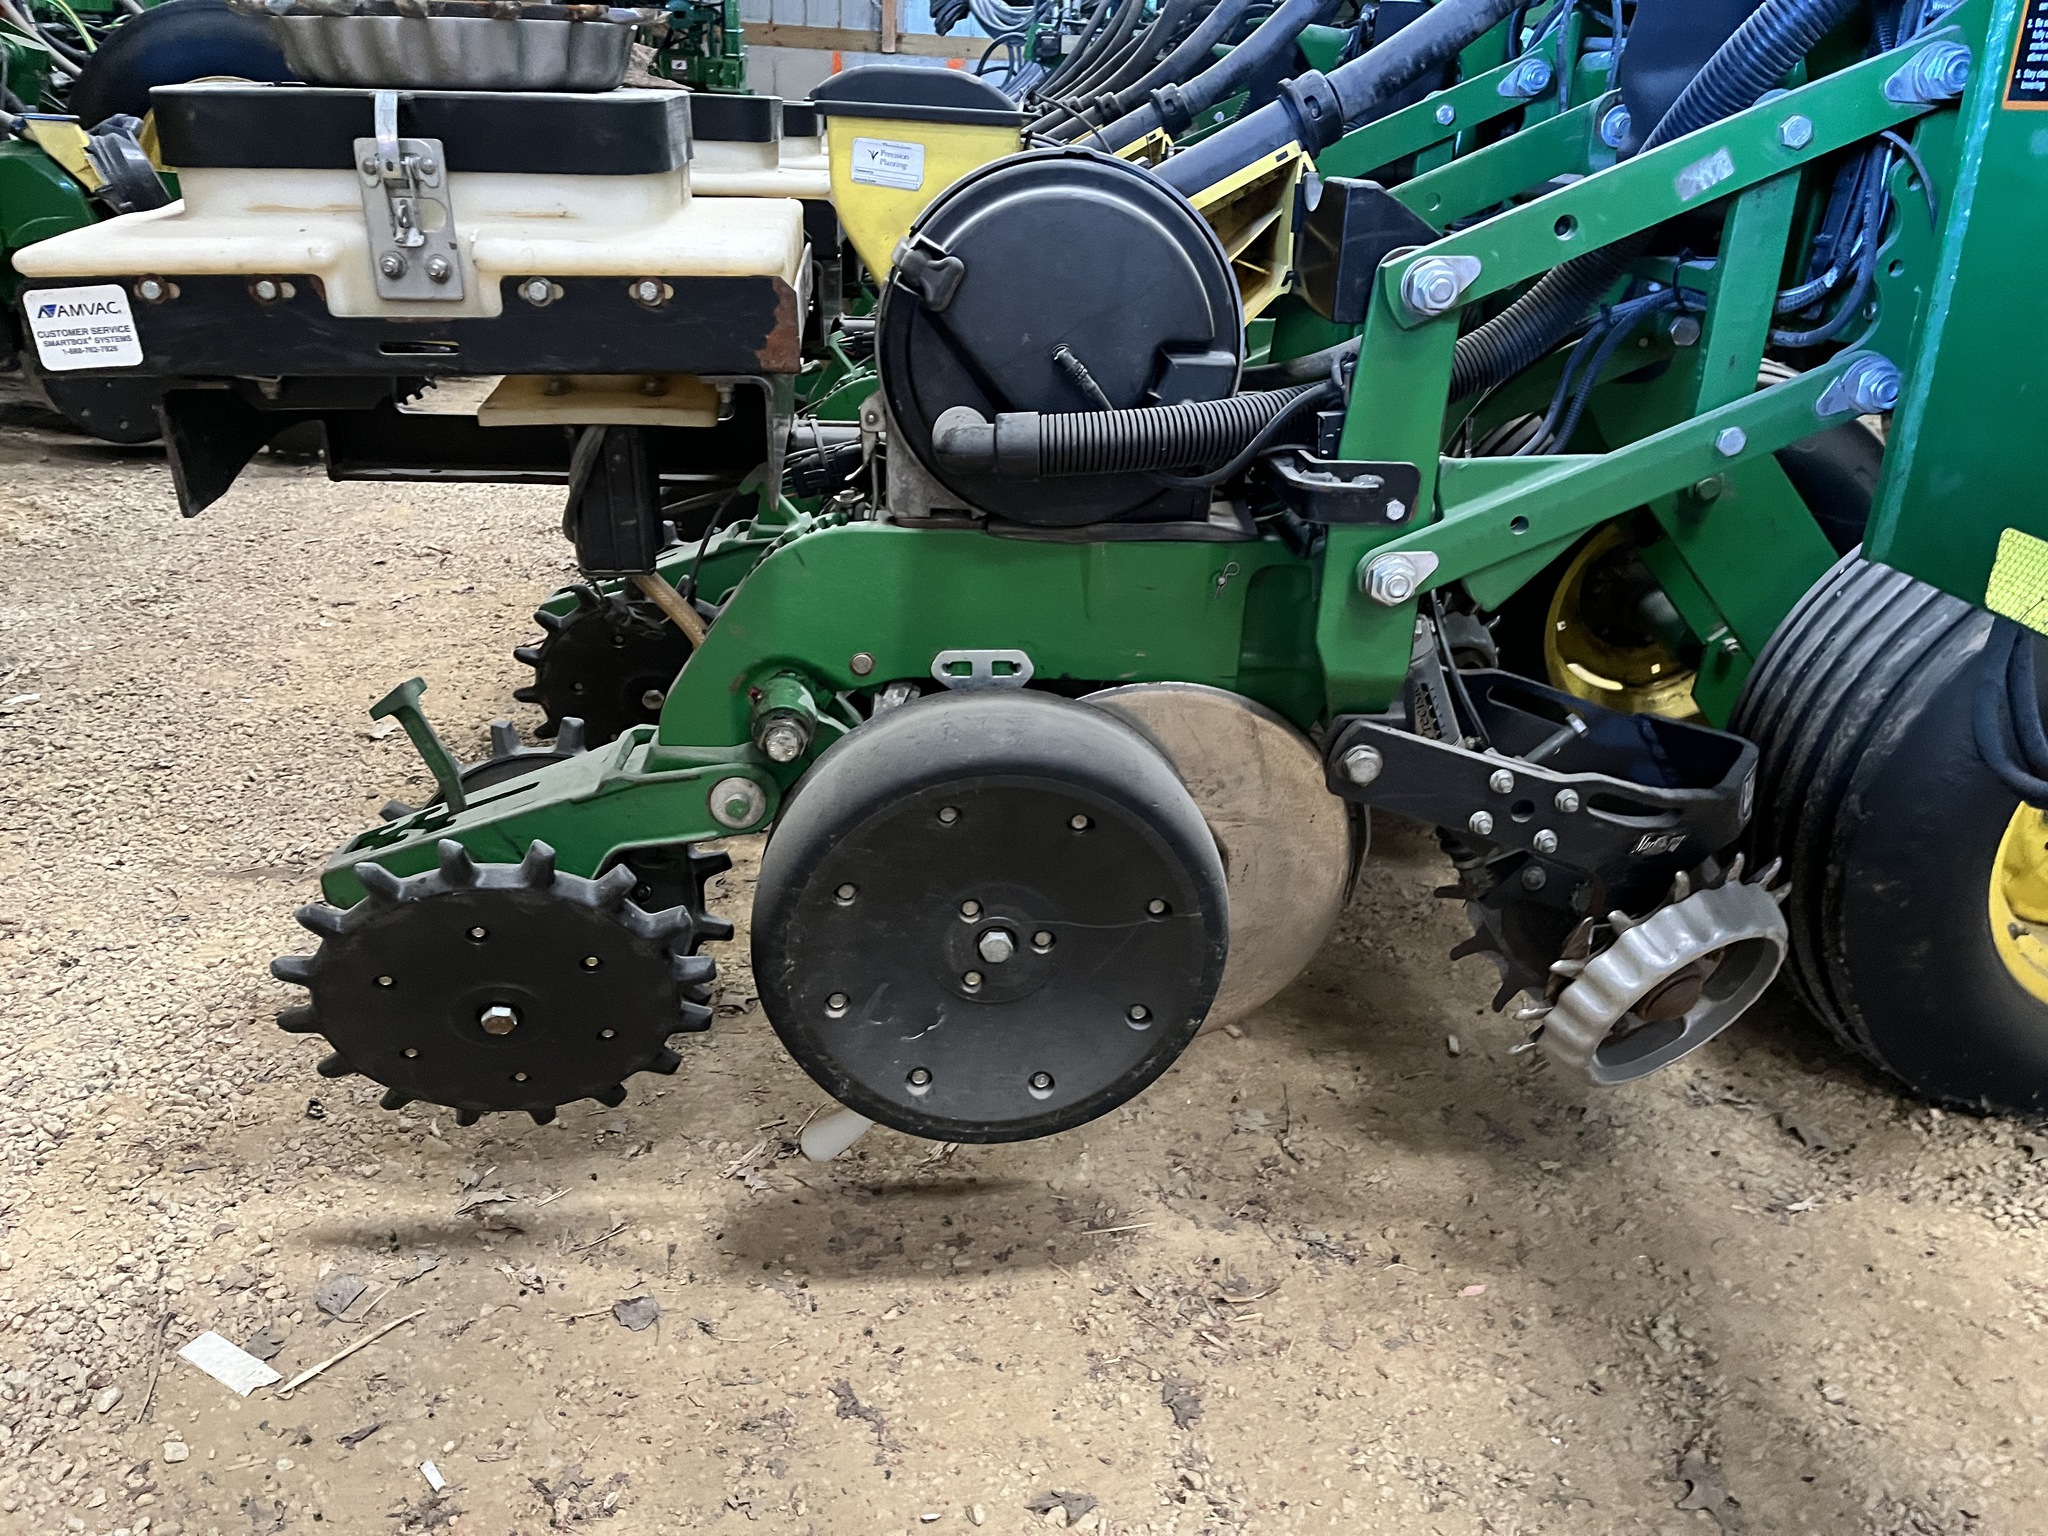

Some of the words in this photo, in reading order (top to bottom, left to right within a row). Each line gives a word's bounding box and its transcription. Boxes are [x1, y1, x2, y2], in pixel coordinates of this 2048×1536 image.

[880, 150, 909, 160] Precision
[880, 159, 908, 170] Planting
[58, 301, 120, 317] AMVAC
[37, 328, 88, 338] CUSTOMER
[90, 325, 130, 334] SERVICE
[94, 335, 132, 343] SYSTEMS
